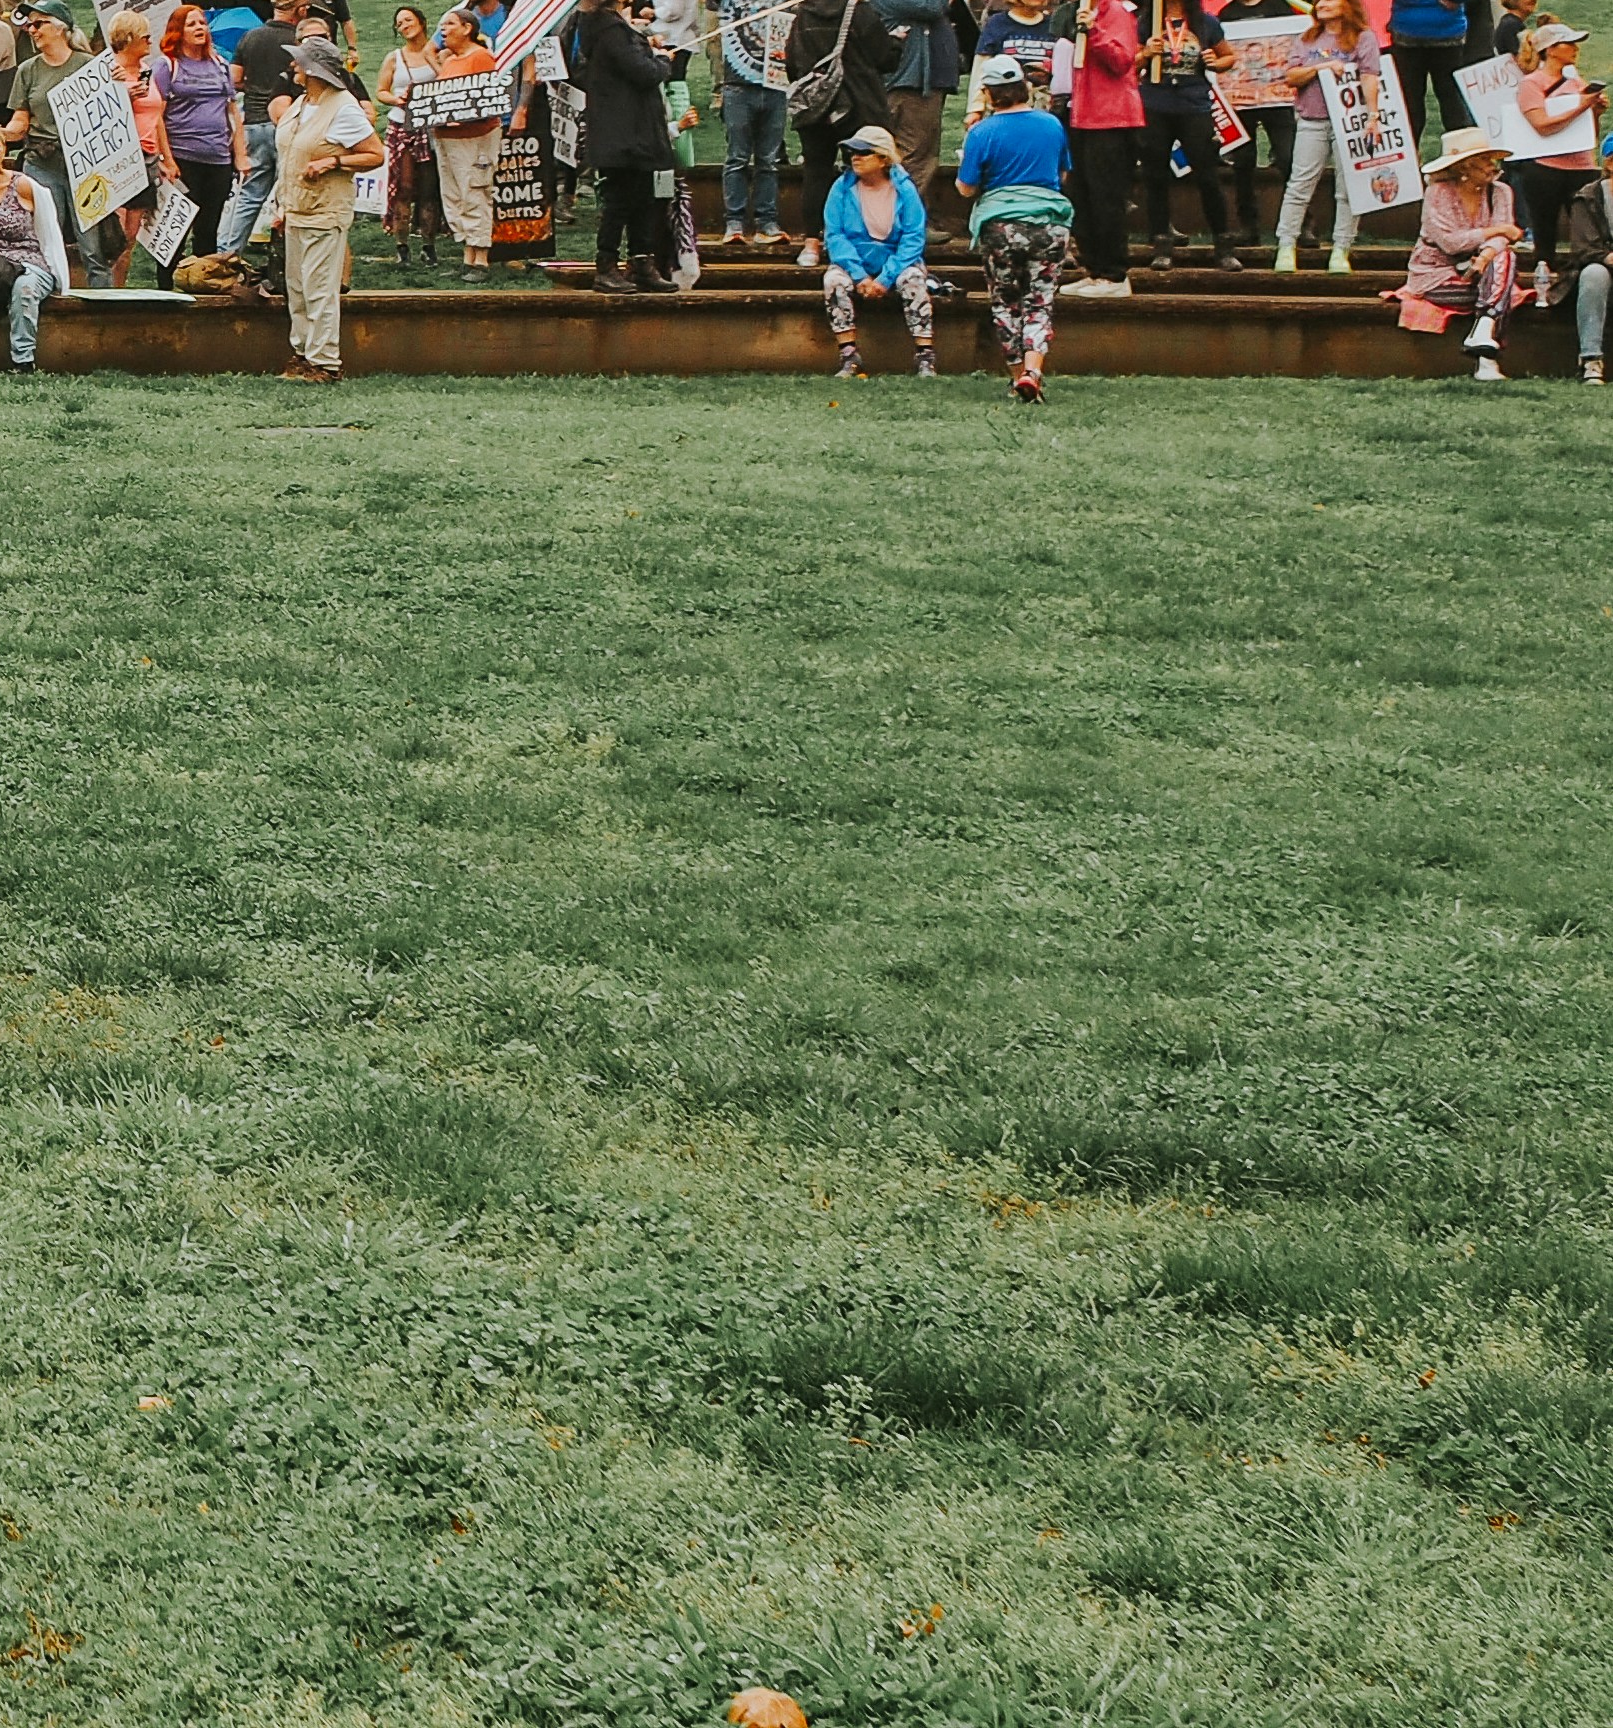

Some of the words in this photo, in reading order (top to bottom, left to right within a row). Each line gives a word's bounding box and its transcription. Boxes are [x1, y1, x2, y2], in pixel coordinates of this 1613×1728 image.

[412, 69, 514, 100] BILLIONAIRES
[1462, 59, 1519, 100] HANDS
[55, 68, 100, 117] HANDS
[477, 94, 511, 108] CLASS
[62, 83, 122, 148] CLEAN
[427, 112, 450, 126] PAY
[481, 105, 513, 118] BILLS
[1341, 110, 1397, 134] LGBQ+
[68, 111, 131, 179] ENERGY
[500, 137, 540, 156] ERO
[1347, 128, 1404, 160] RIHTS
[497, 155, 541, 172] ddles
[495, 168, 534, 184] while
[355, 177, 384, 198] FF!
[491, 182, 544, 204] ROME
[496, 205, 544, 221] burns
